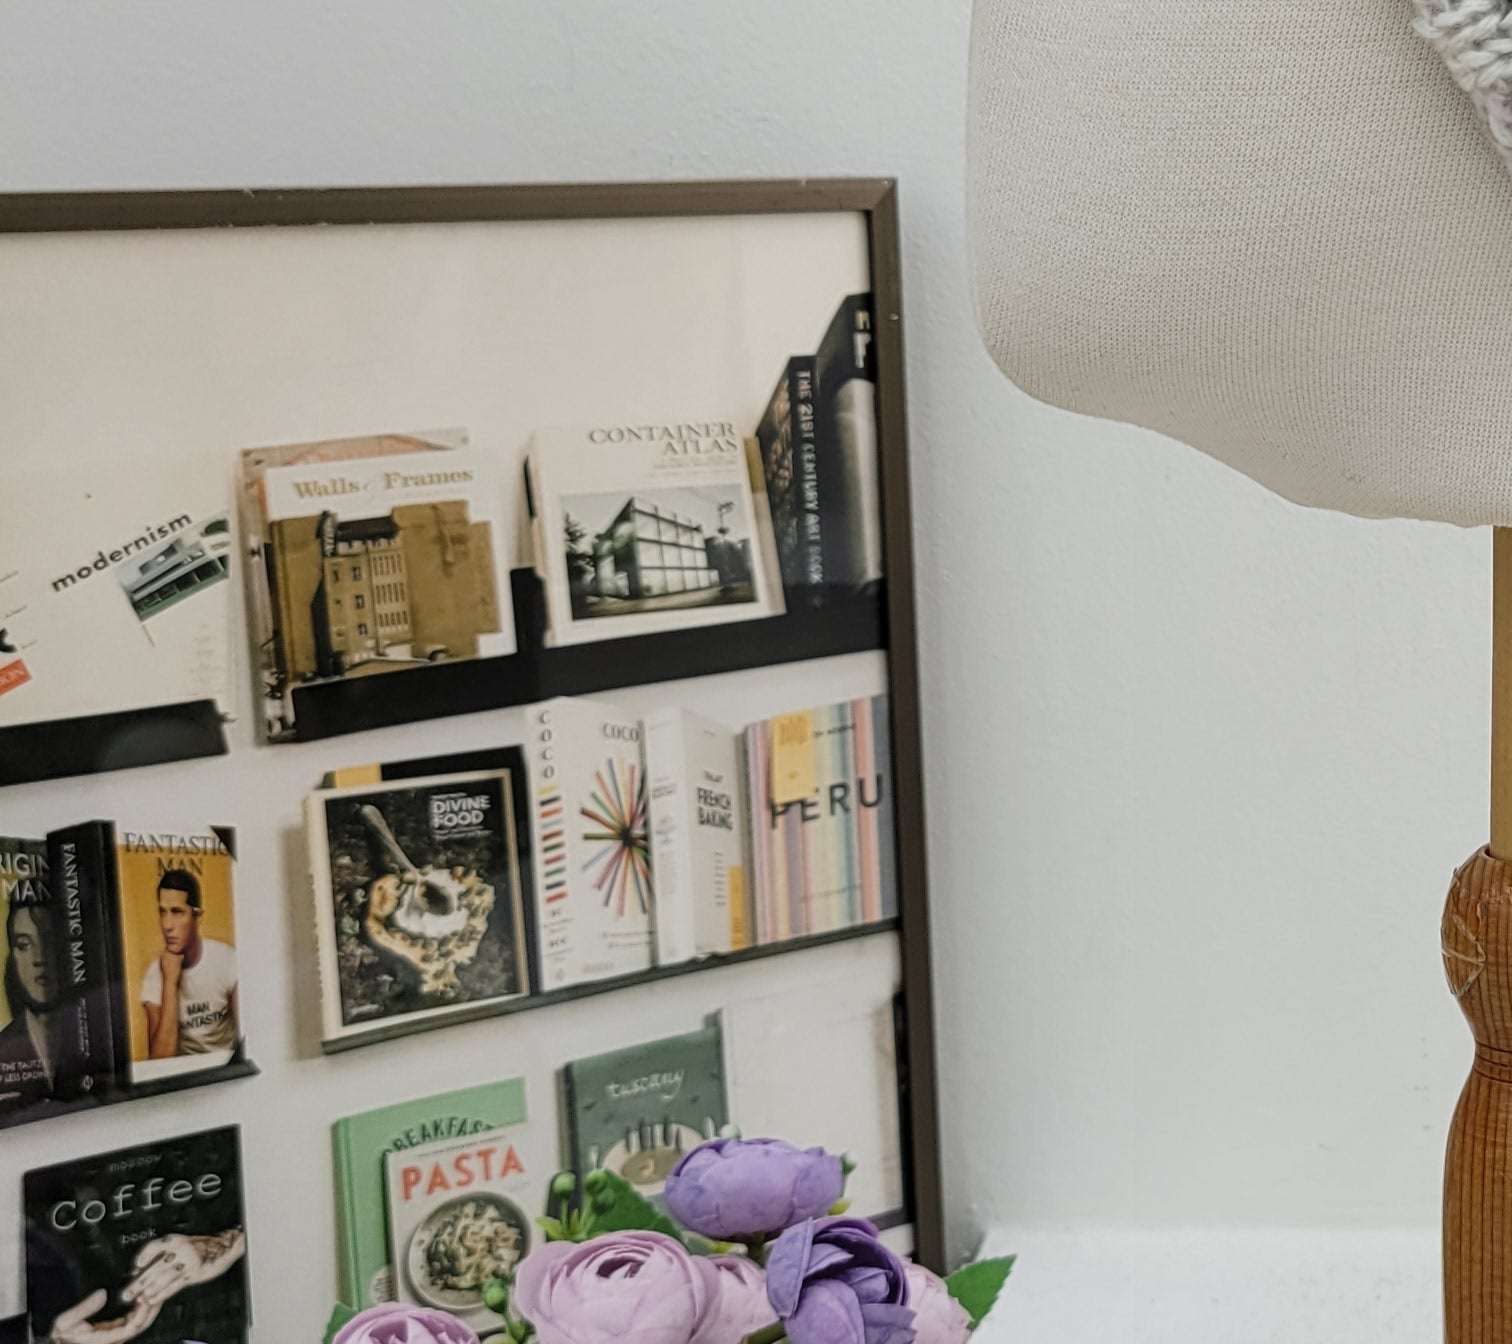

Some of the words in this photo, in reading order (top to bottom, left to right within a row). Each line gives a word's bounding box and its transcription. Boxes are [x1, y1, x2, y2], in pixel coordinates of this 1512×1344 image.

[588, 422, 737, 445] CONTAINER
[663, 438, 739, 457] ATLAS
[293, 477, 361, 499] Walls
[383, 469, 474, 491] Frames
[51, 514, 193, 593] modernism
[433, 795, 491, 813] DIVINE
[768, 773, 883, 831] PERU
[433, 809, 486, 829] FOOD
[124, 832, 231, 857] FANTASTIC
[157, 856, 203, 878] MAN
[63, 843, 83, 936] FANTASTIC
[70, 940, 87, 984] MAN
[401, 1143, 525, 1201] PASTA
[121, 1228, 158, 1245] book
